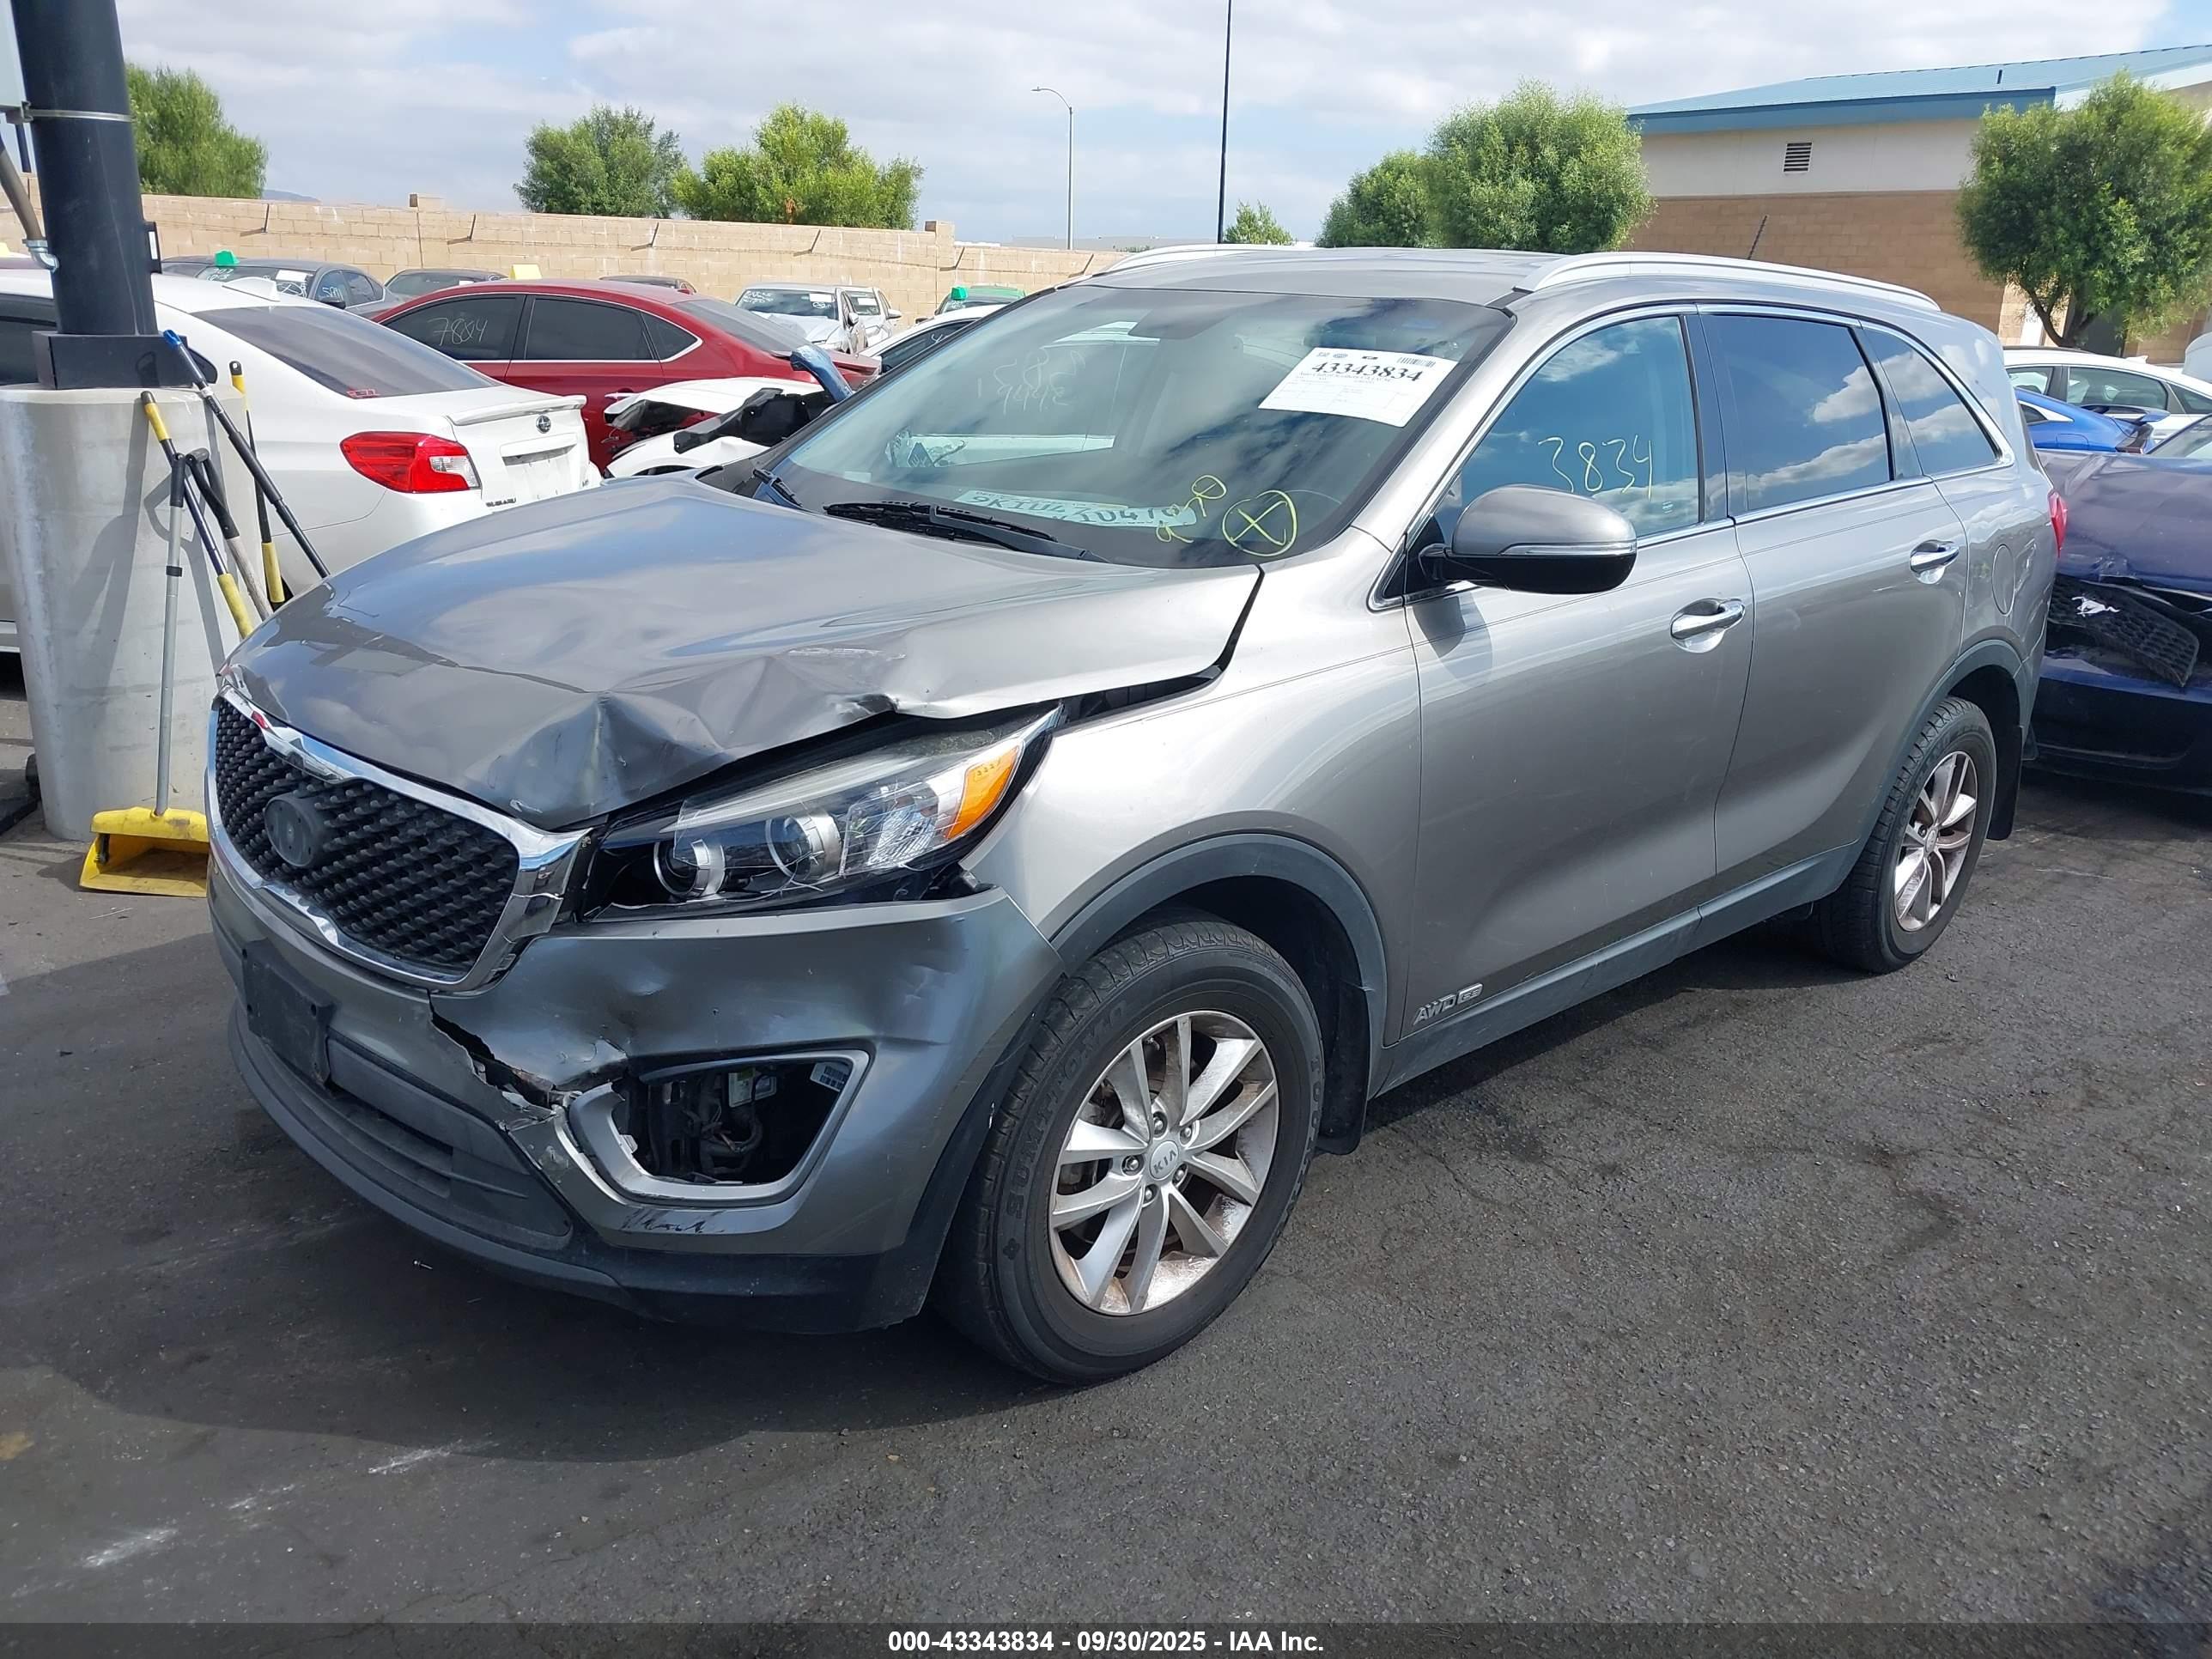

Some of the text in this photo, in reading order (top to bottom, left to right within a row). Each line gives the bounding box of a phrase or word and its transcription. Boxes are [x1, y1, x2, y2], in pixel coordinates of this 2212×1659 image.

[1312, 362, 1423, 381] 43343834
[1538, 434, 1653, 501] 3834
[1413, 994, 1456, 1025] AWD
[1153, 1150, 1177, 1174] KIA
